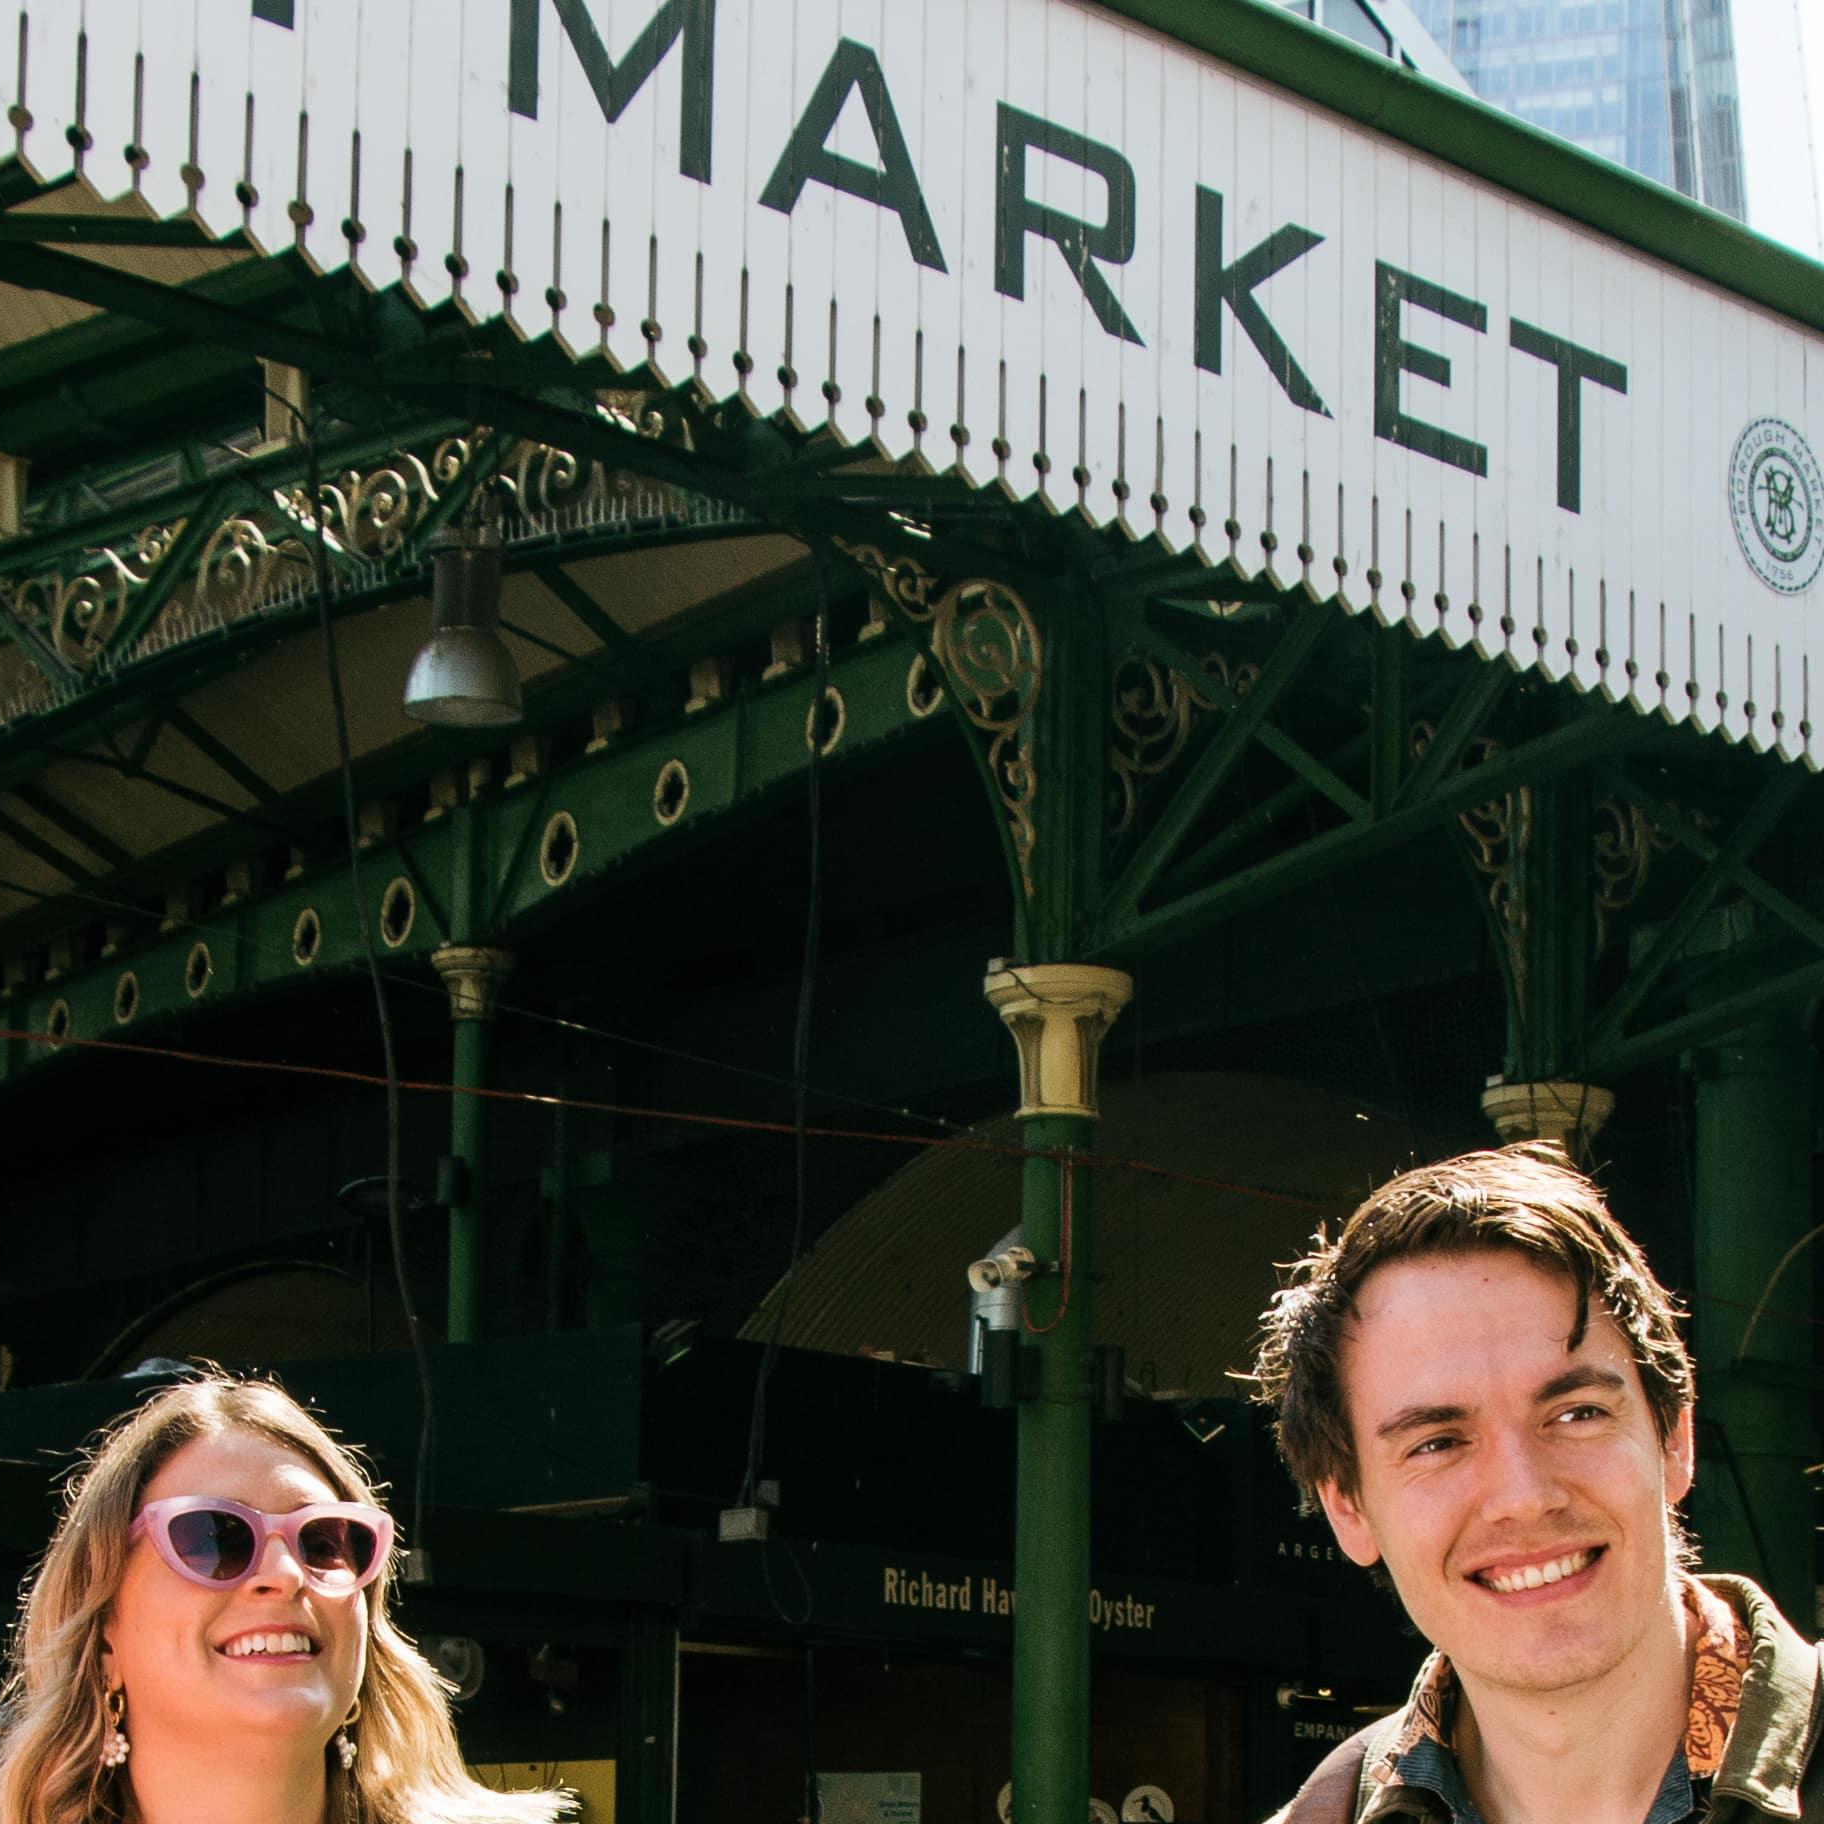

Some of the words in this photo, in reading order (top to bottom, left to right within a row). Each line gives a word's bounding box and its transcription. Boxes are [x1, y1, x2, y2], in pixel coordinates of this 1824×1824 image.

[509, 0, 1628, 515] MARKET
[1735, 428, 1786, 515] BOROUGH
[1791, 444, 1824, 545] MARKET
[1765, 559, 1795, 581] 1756
[884, 1567, 972, 1611] Richard
[1088, 1589, 1156, 1631] Oyster
